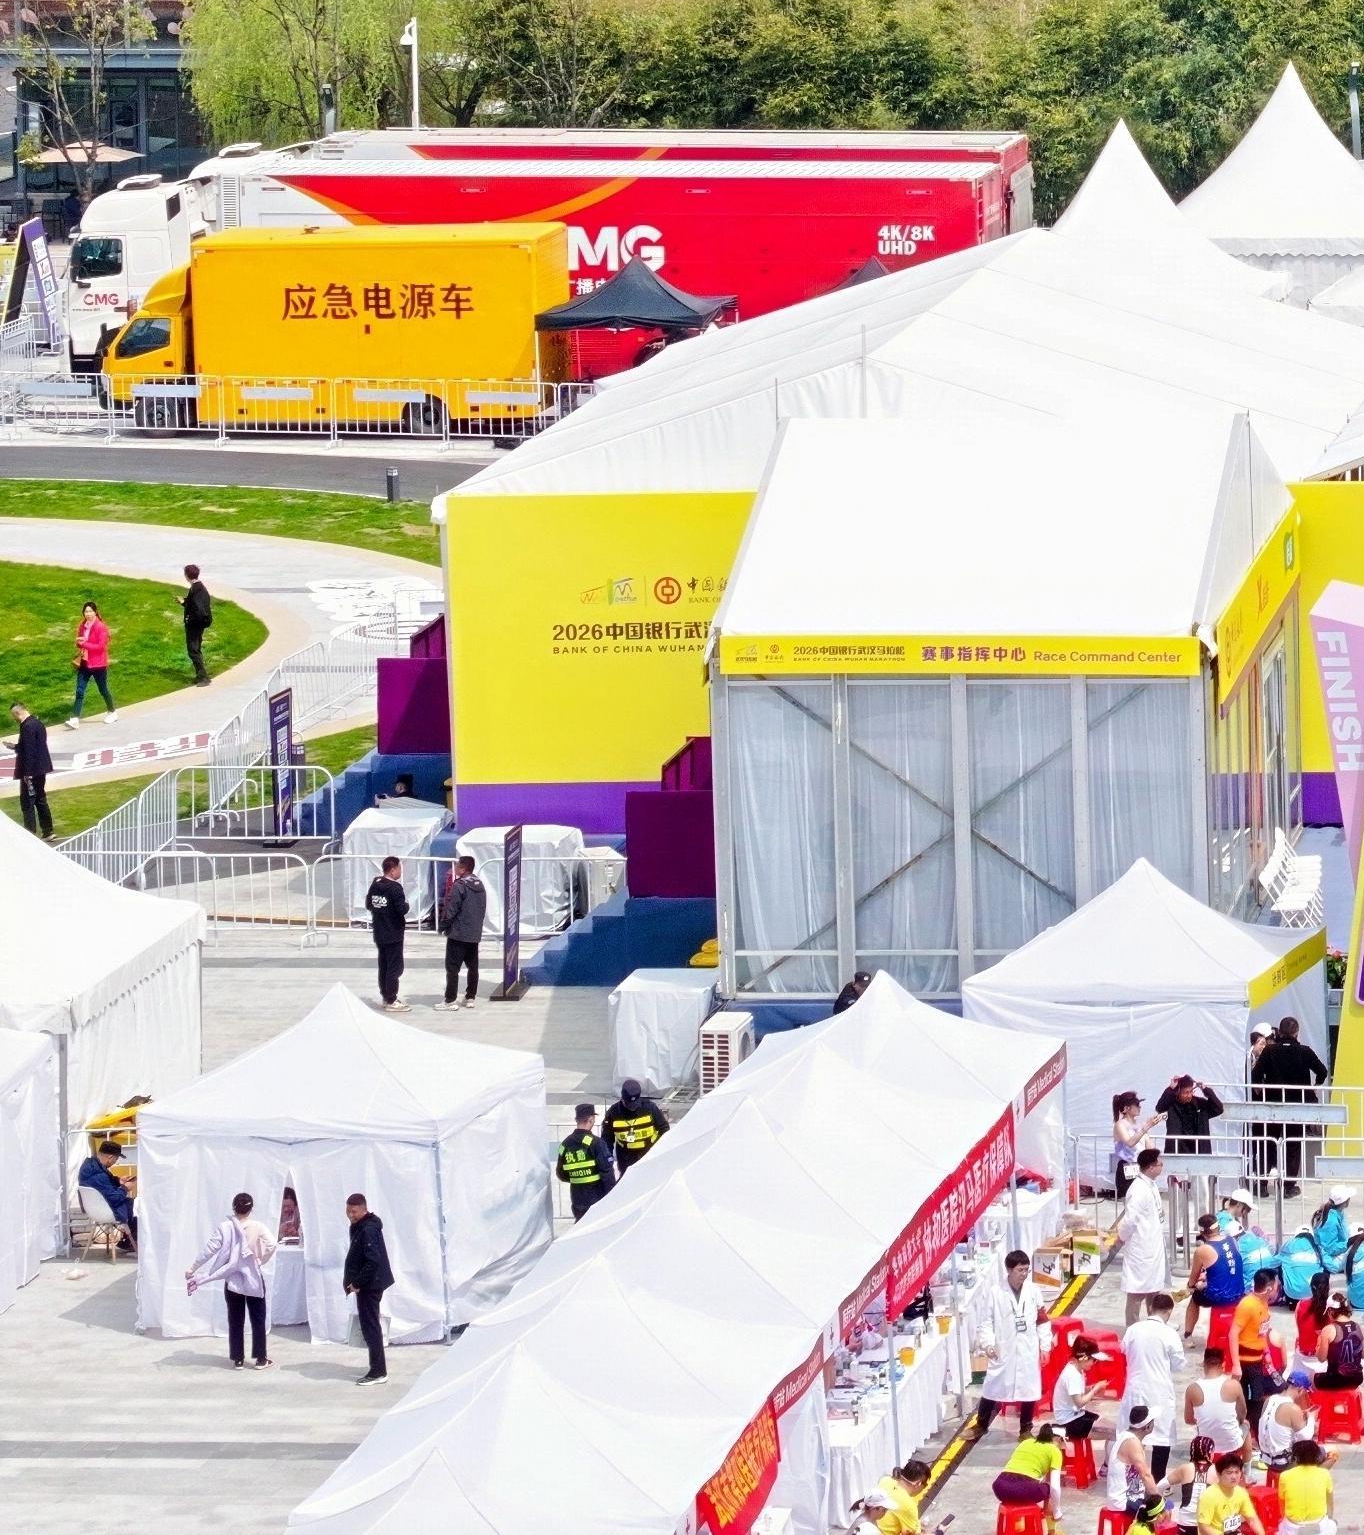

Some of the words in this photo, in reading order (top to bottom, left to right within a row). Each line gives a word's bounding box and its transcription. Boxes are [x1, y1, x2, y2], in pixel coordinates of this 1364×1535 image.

[878, 225, 935, 241] 4K/8K
[878, 241, 917, 255] UHD
[84, 293, 119, 306] CMG
[282, 283, 474, 321] 应急电源车
[553, 646, 587, 654] BANK
[593, 646, 608, 654] OF
[658, 645, 704, 653] WUHAN
[922, 646, 1027, 662] 赛事指挥中心
[1034, 651, 1067, 662] Race
[1070, 651, 1134, 662] Command
[1138, 651, 1181, 662] Center
[785, 1371, 807, 1405] Medical
